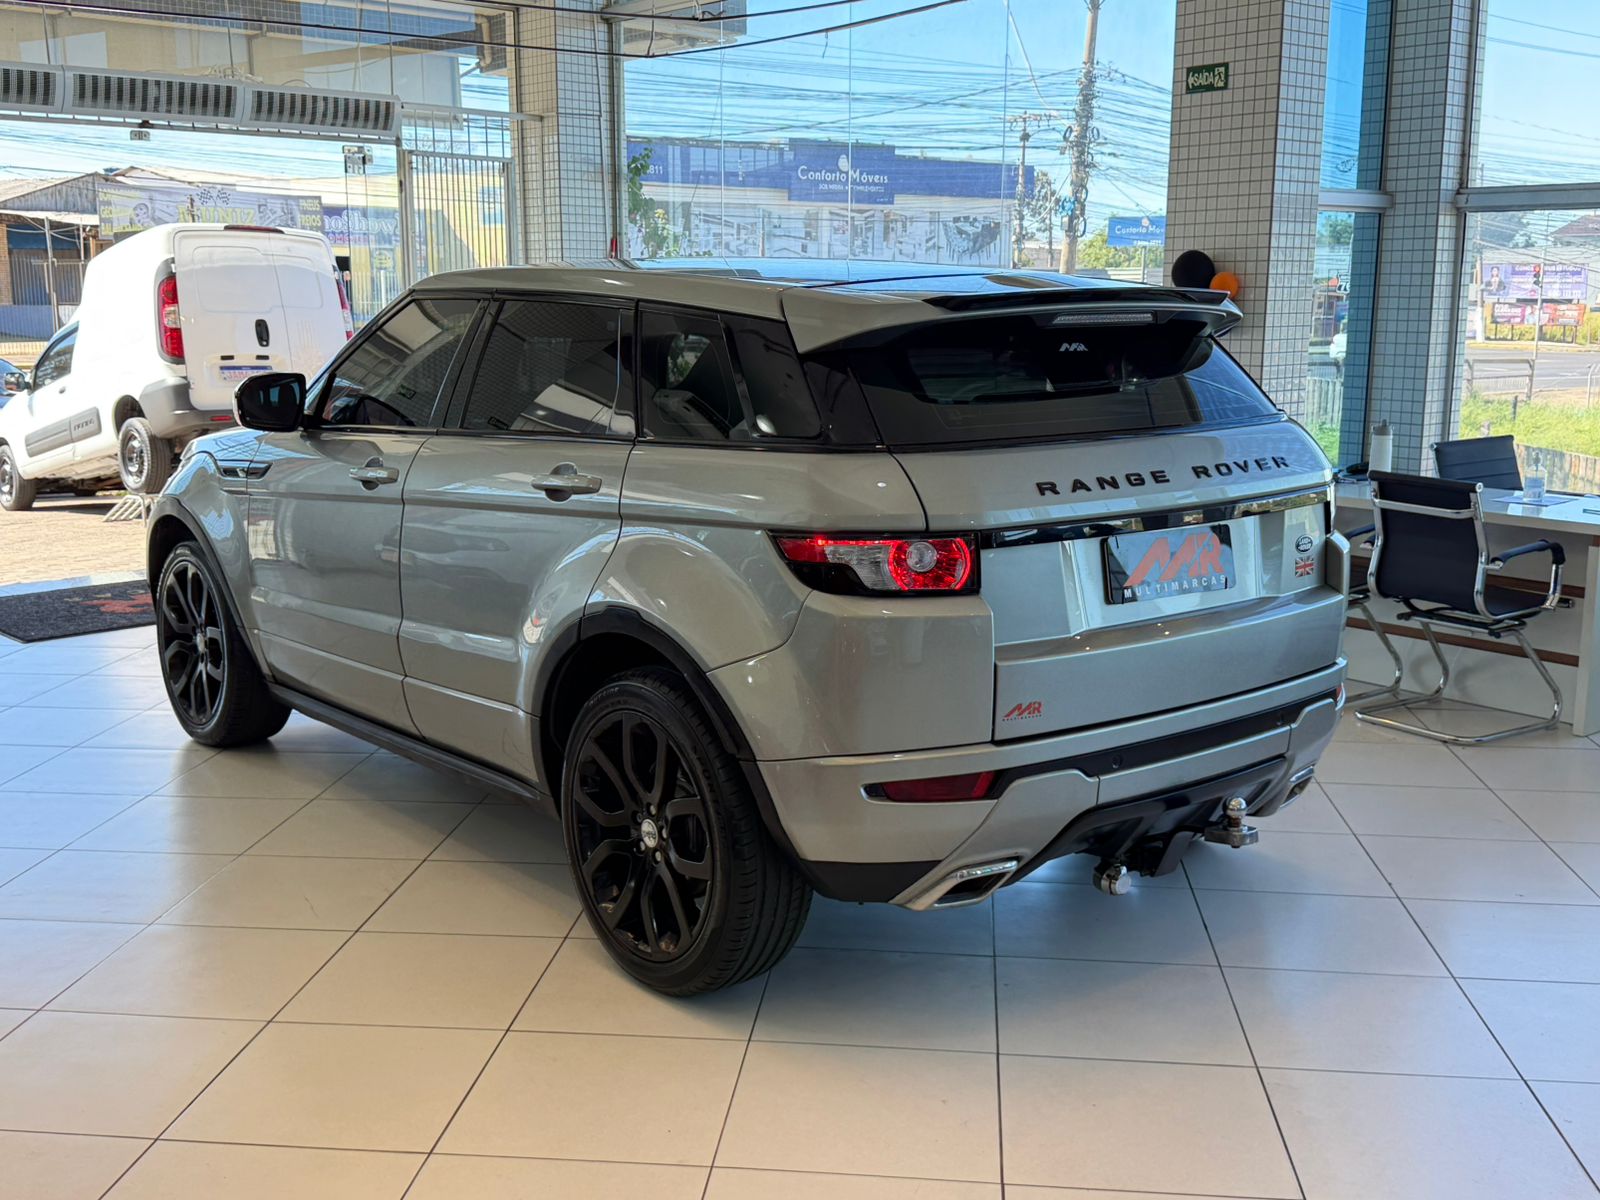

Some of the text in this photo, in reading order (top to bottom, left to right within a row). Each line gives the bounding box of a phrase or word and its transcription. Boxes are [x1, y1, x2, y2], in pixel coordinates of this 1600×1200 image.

[1193, 69, 1214, 86] SAÍDA
[797, 165, 889, 183] Conforto Móveis
[1035, 456, 1290, 496] RANGE ROVER
[1124, 576, 1226, 599] MULTIMARCAS
